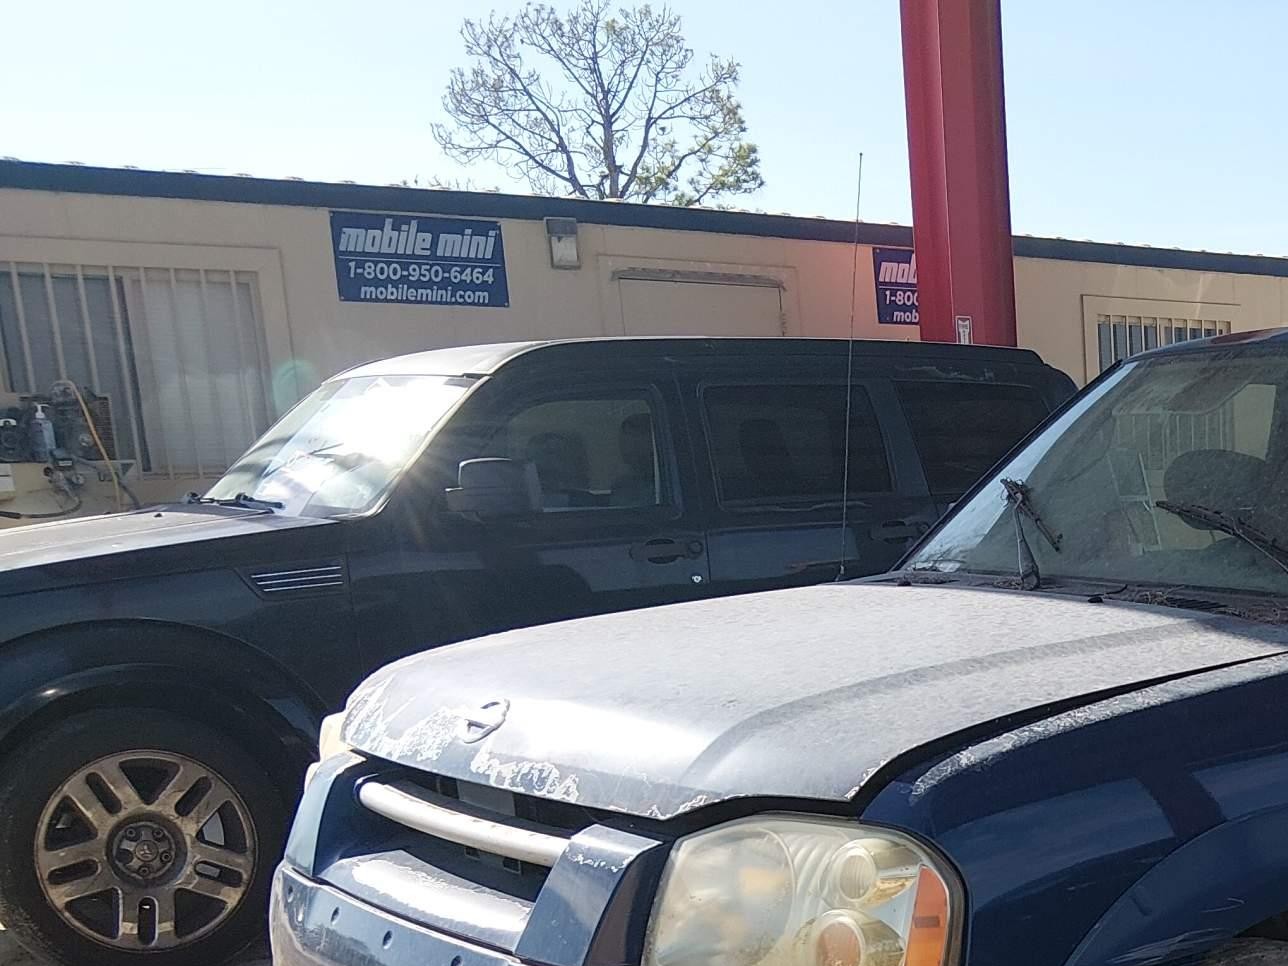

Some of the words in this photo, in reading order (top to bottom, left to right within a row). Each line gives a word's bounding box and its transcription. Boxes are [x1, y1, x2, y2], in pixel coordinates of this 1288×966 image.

[339, 218, 433, 256] mobile
[436, 228, 496, 259] mini
[348, 261, 495, 285] 1-800-950-6464
[360, 284, 489, 304] mobilemini.com
